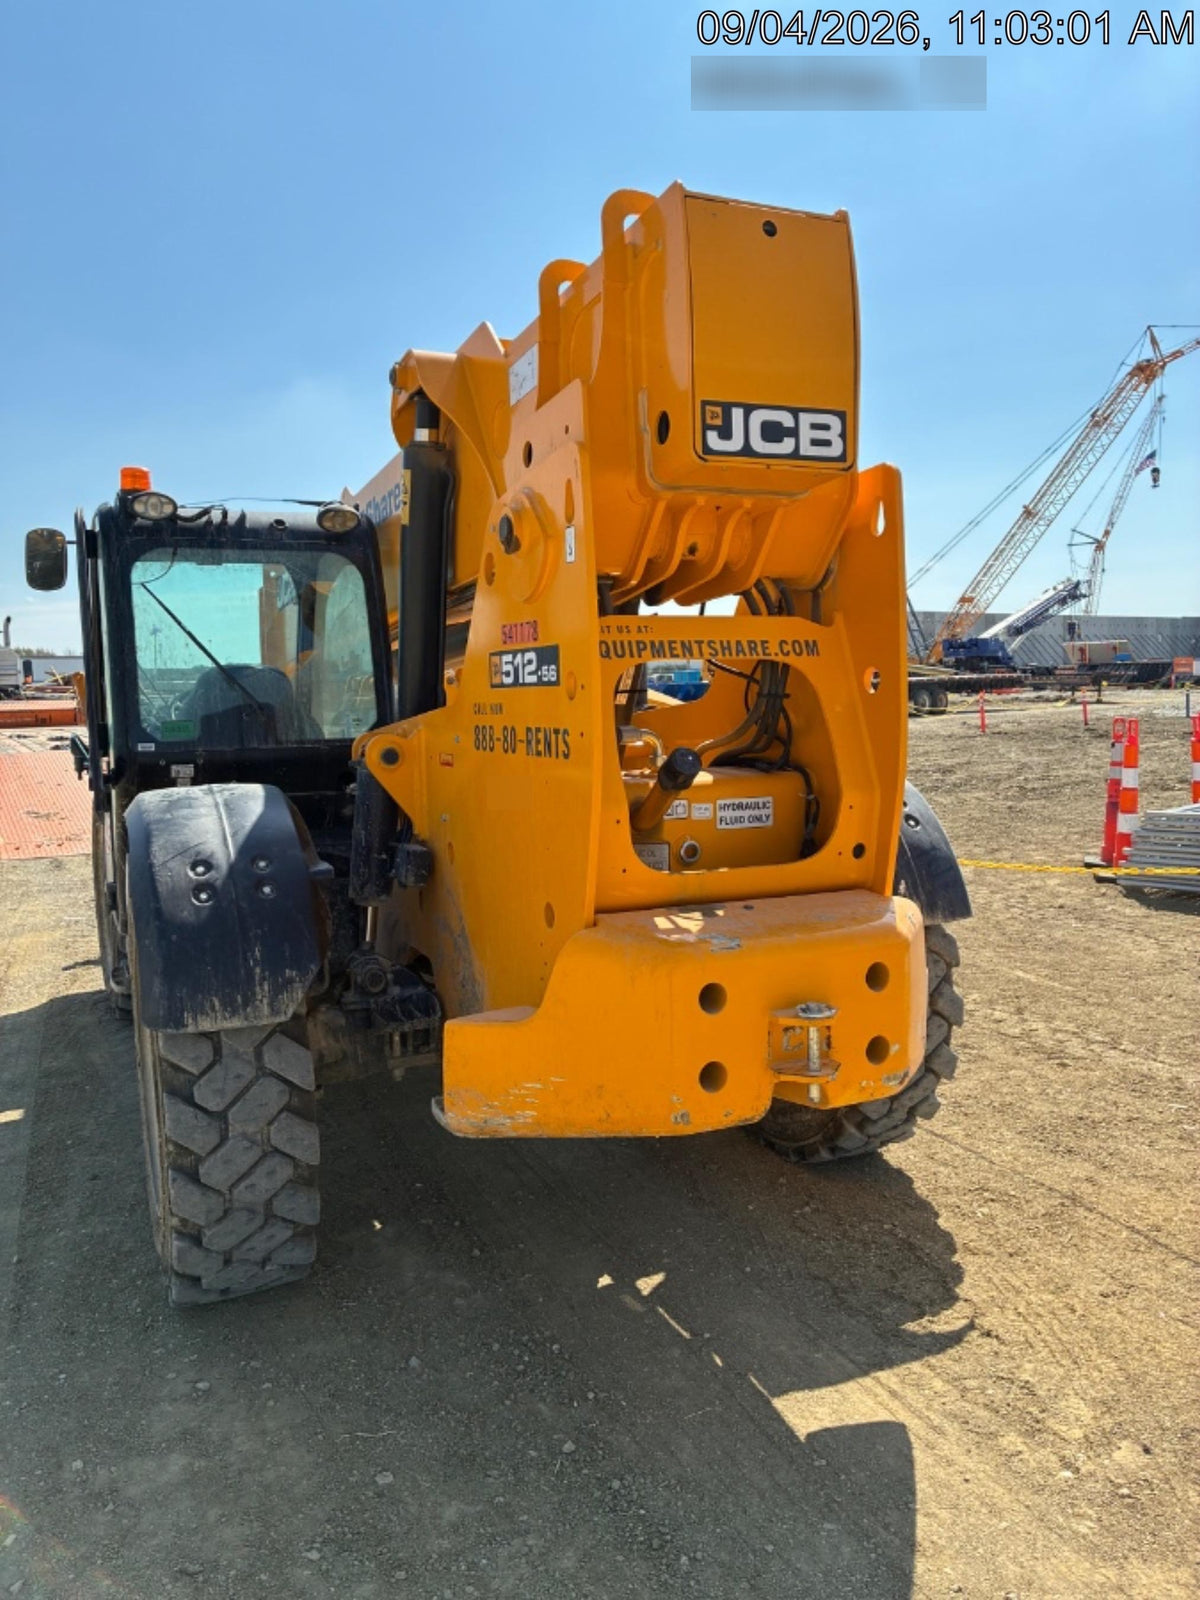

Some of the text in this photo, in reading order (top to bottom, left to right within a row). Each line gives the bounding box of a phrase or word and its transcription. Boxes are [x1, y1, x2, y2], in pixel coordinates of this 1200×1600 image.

[706, 406, 844, 458] JCB
[616, 625, 631, 635] US
[636, 625, 654, 635] AT:
[598, 639, 820, 660] QUIPMENTSHARE.COM
[473, 724, 571, 761] 888-80-RENTS
[718, 800, 772, 812] HYDRAULIC
[719, 813, 772, 826] FLUID ONLY
